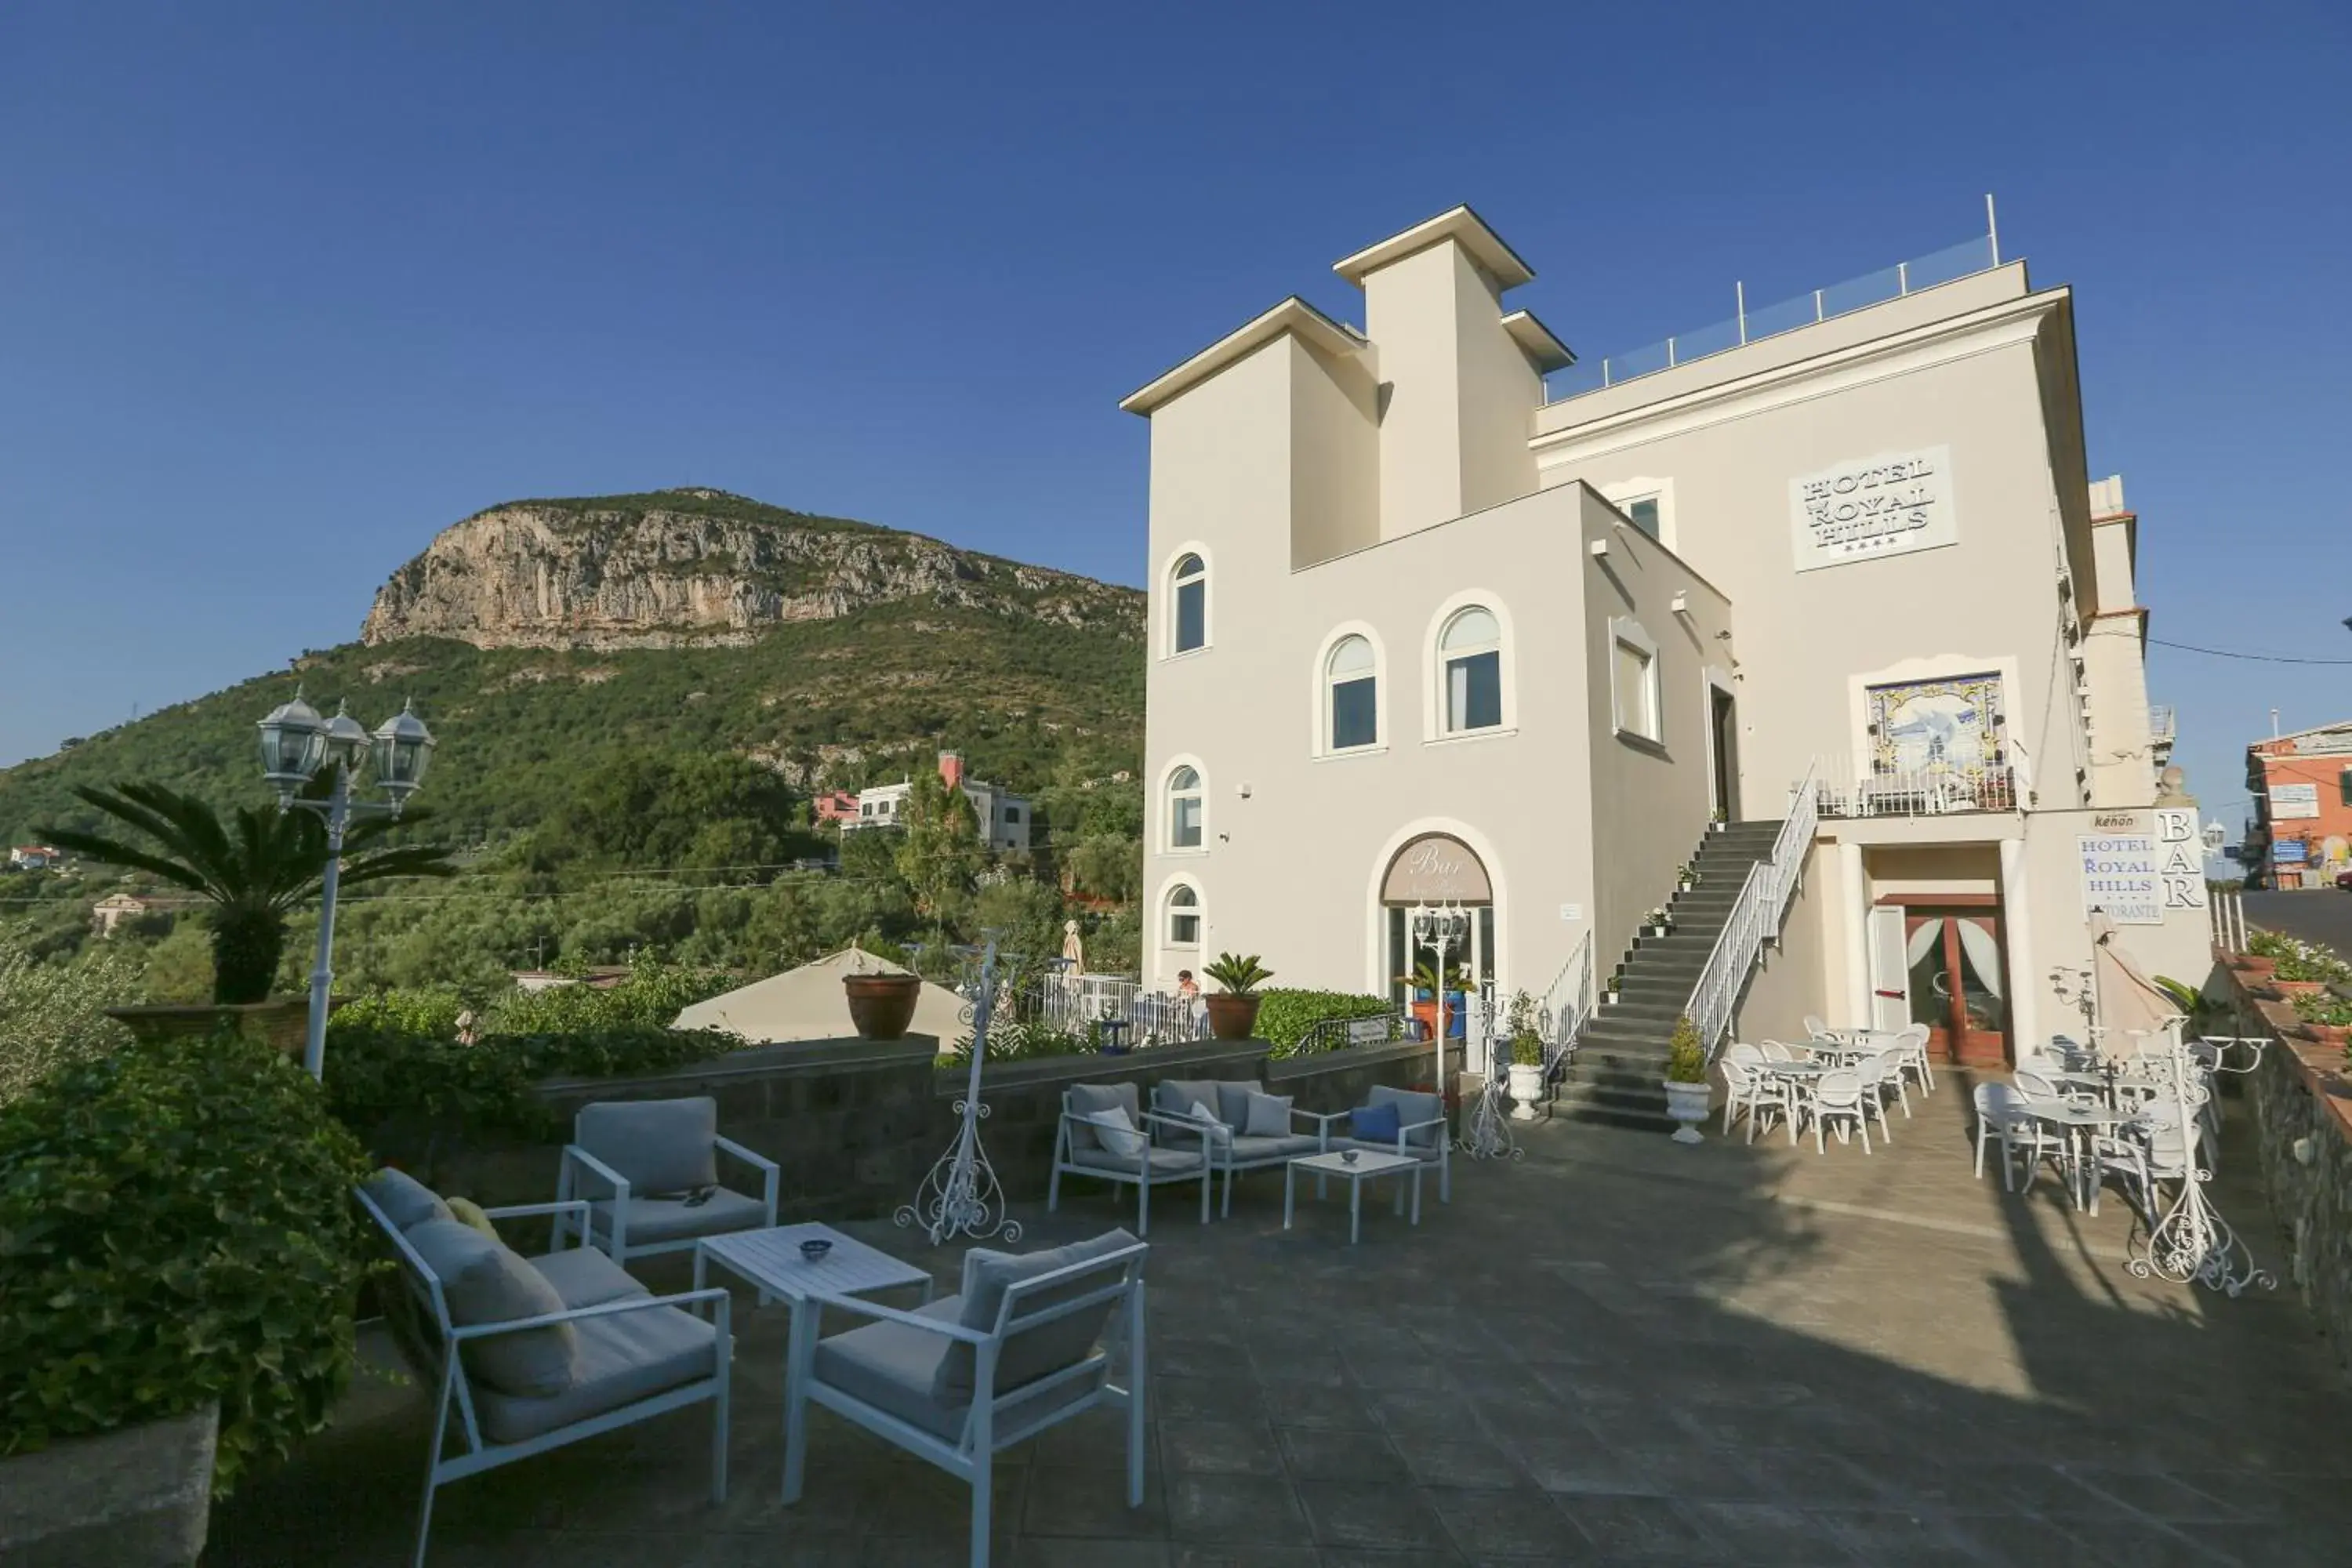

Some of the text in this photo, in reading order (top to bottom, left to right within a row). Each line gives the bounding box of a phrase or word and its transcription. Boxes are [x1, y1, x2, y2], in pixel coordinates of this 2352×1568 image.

[1802, 459, 1933, 502] HOTEL
[1806, 486, 1936, 528] ROYAL
[1815, 510, 1928, 548] HILLS
[2082, 840, 2154, 852] HOTEL
[2158, 811, 2205, 908] BAR
[2083, 859, 2155, 873] ROYAL
[2089, 880, 2153, 891] HILLS
